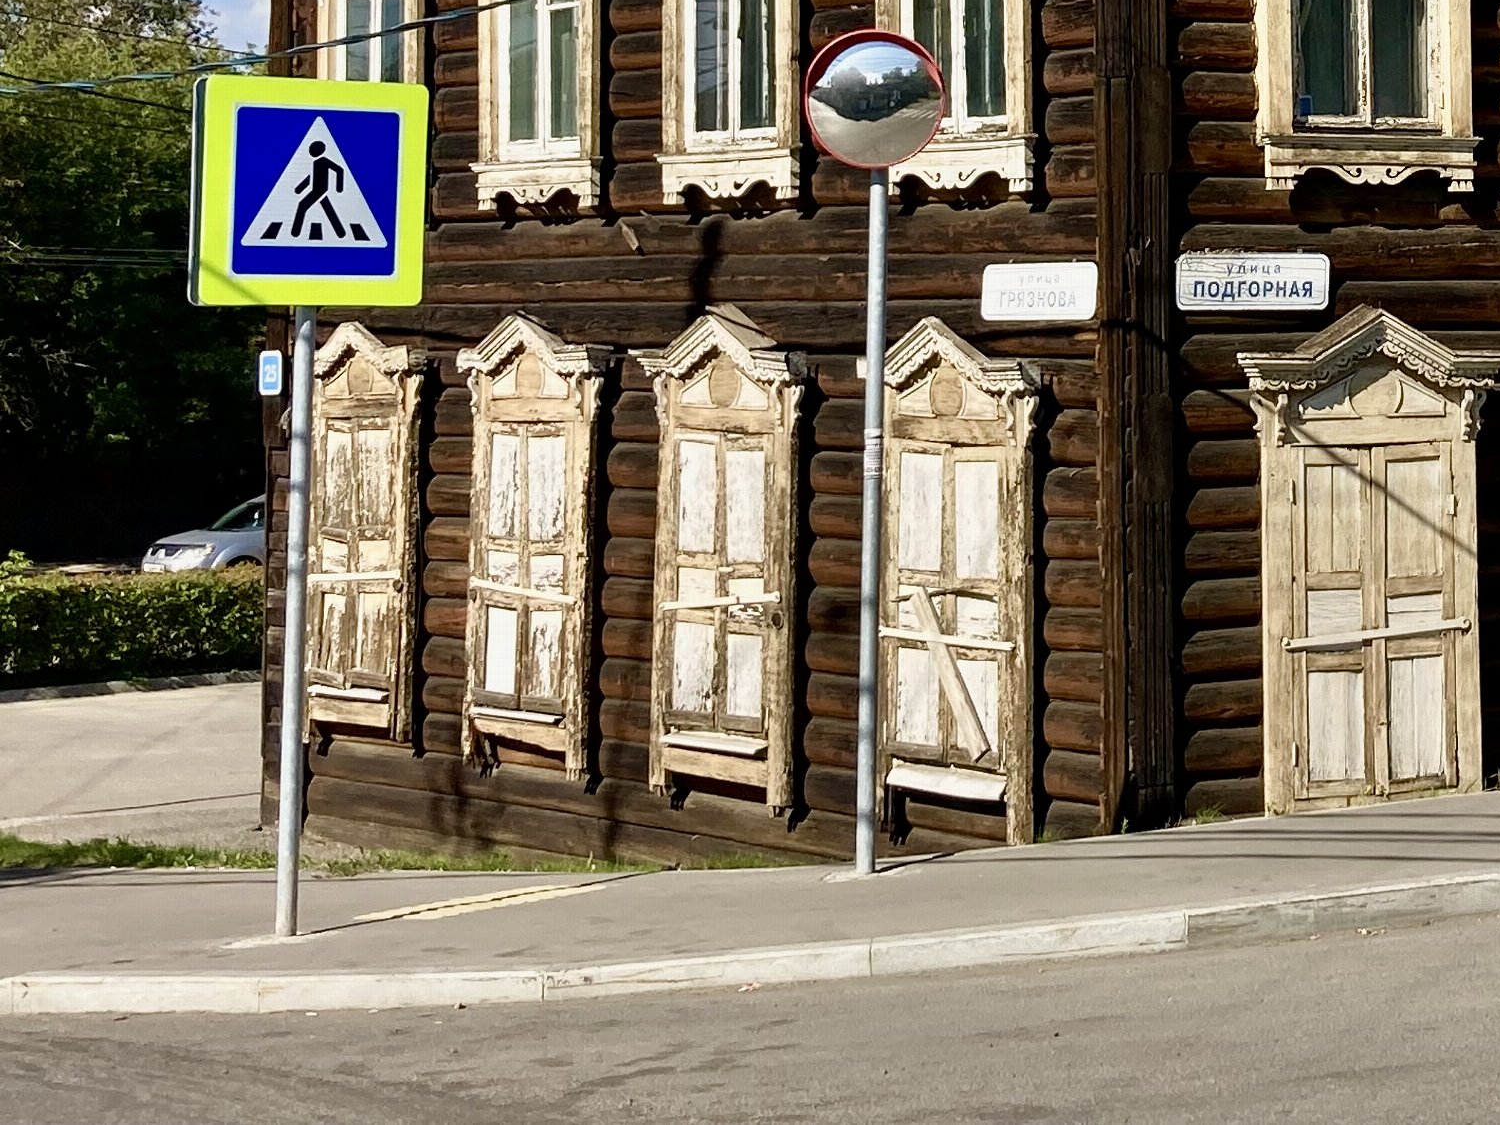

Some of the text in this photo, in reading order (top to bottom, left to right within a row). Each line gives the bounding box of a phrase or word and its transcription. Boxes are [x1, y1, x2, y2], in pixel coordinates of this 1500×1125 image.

[1226, 264, 1281, 278] улица
[1019, 274, 1060, 287] улица
[1193, 280, 1313, 300] ПОДГОРНАЯ
[1000, 291, 1076, 308] ГРЯЗНОВА
